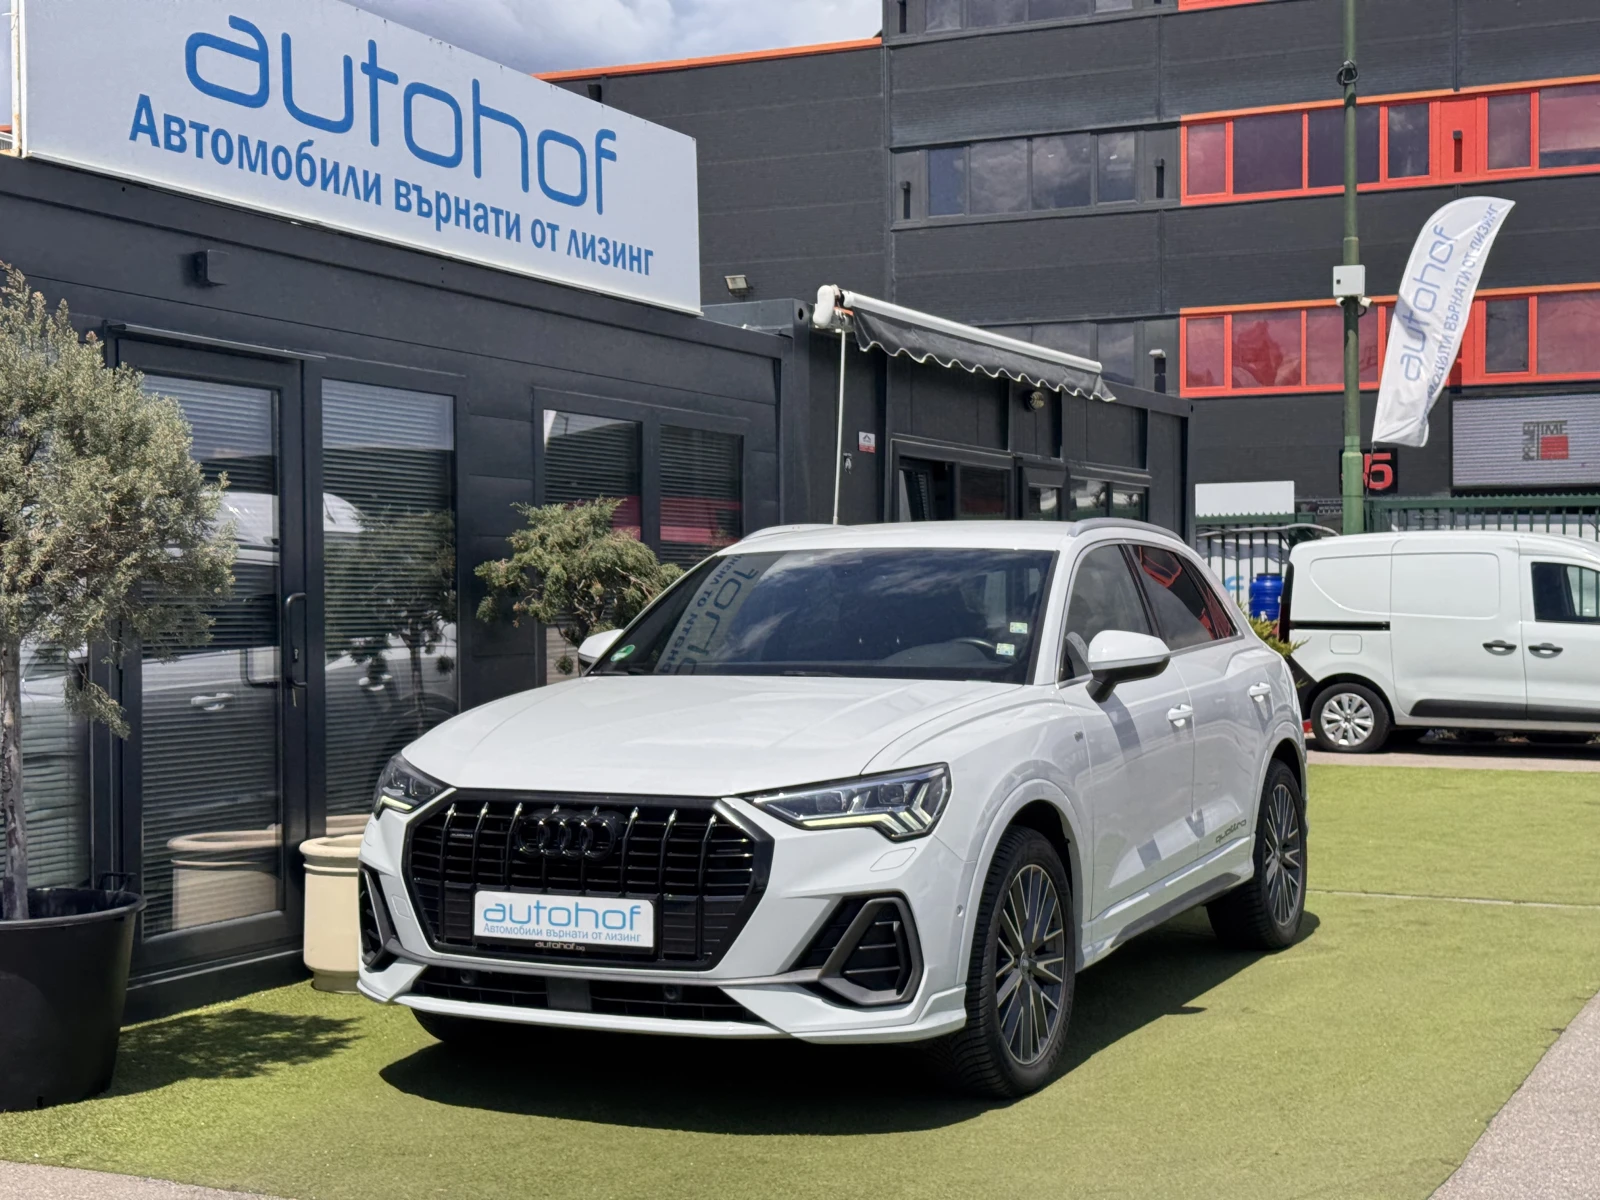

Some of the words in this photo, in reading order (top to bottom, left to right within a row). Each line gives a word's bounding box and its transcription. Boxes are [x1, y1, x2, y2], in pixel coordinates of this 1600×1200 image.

[129, 94, 382, 206] Автомобили
[394, 178, 521, 243] върнати
[531, 218, 560, 252] от
[567, 229, 654, 276] лизинг
[185, 15, 617, 215] autohof
[1400, 225, 1456, 381] autohof
[483, 900, 641, 931] autohof
[483, 923, 543, 937] Автомобили
[546, 928, 588, 939] върнати
[591, 932, 602, 940] от
[605, 933, 641, 942] лизинг
